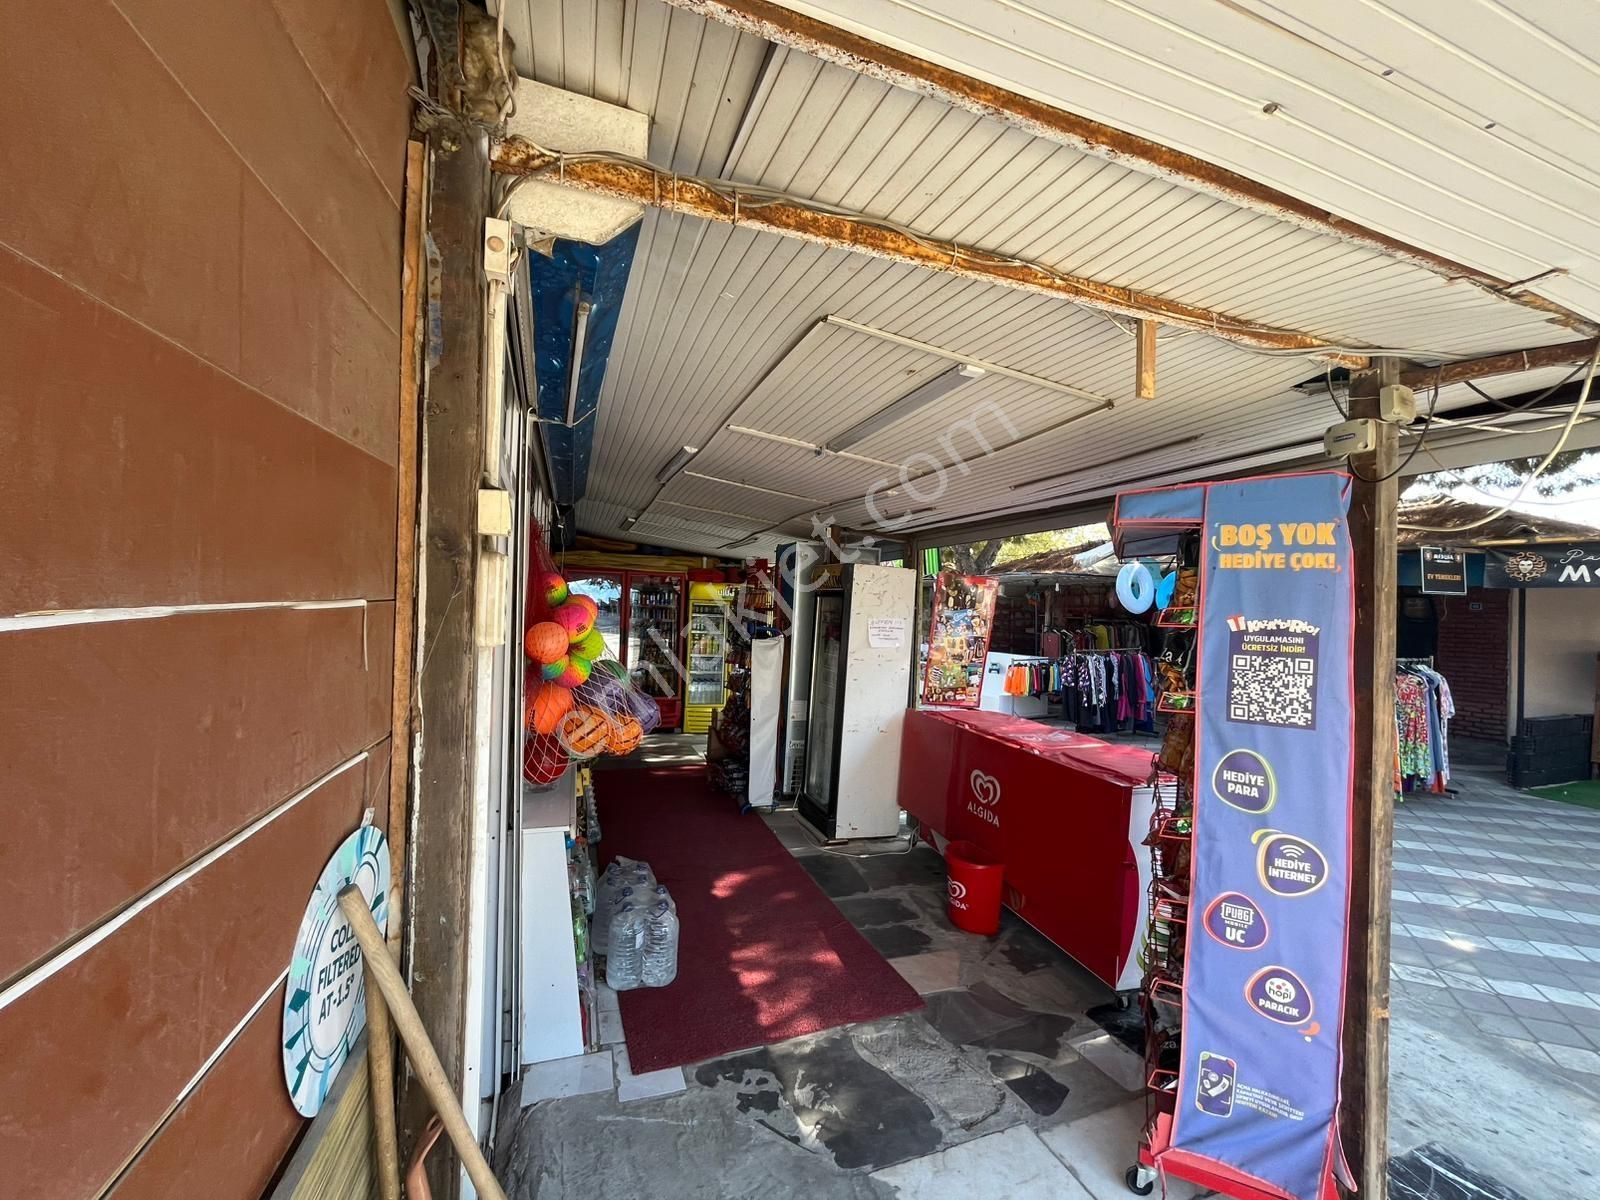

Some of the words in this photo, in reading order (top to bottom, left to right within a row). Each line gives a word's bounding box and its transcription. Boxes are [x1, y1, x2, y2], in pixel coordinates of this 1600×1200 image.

[1219, 522, 1273, 549] BOŞ
[1278, 521, 1337, 546] YOK
[1219, 552, 1285, 569] HEDİYE
[1290, 552, 1336, 574] ÇOK!
[1241, 643, 1279, 652] ÜCRETSİZ
[1244, 635, 1304, 644] UYGULAMASINI
[1223, 770, 1265, 786] HEDİYE
[1227, 782, 1259, 798] PARA
[967, 801, 1000, 828] ALGIDA
[1274, 858, 1311, 872] HEDİYE
[1268, 866, 1317, 884] İNTERNET
[1225, 906, 1249, 921] PUBG
[330, 923, 356, 953] COL
[1225, 926, 1246, 943] UC
[317, 943, 362, 994] FILTERED
[1268, 985, 1292, 1000] hopi
[1258, 998, 1300, 1018] PARACIK
